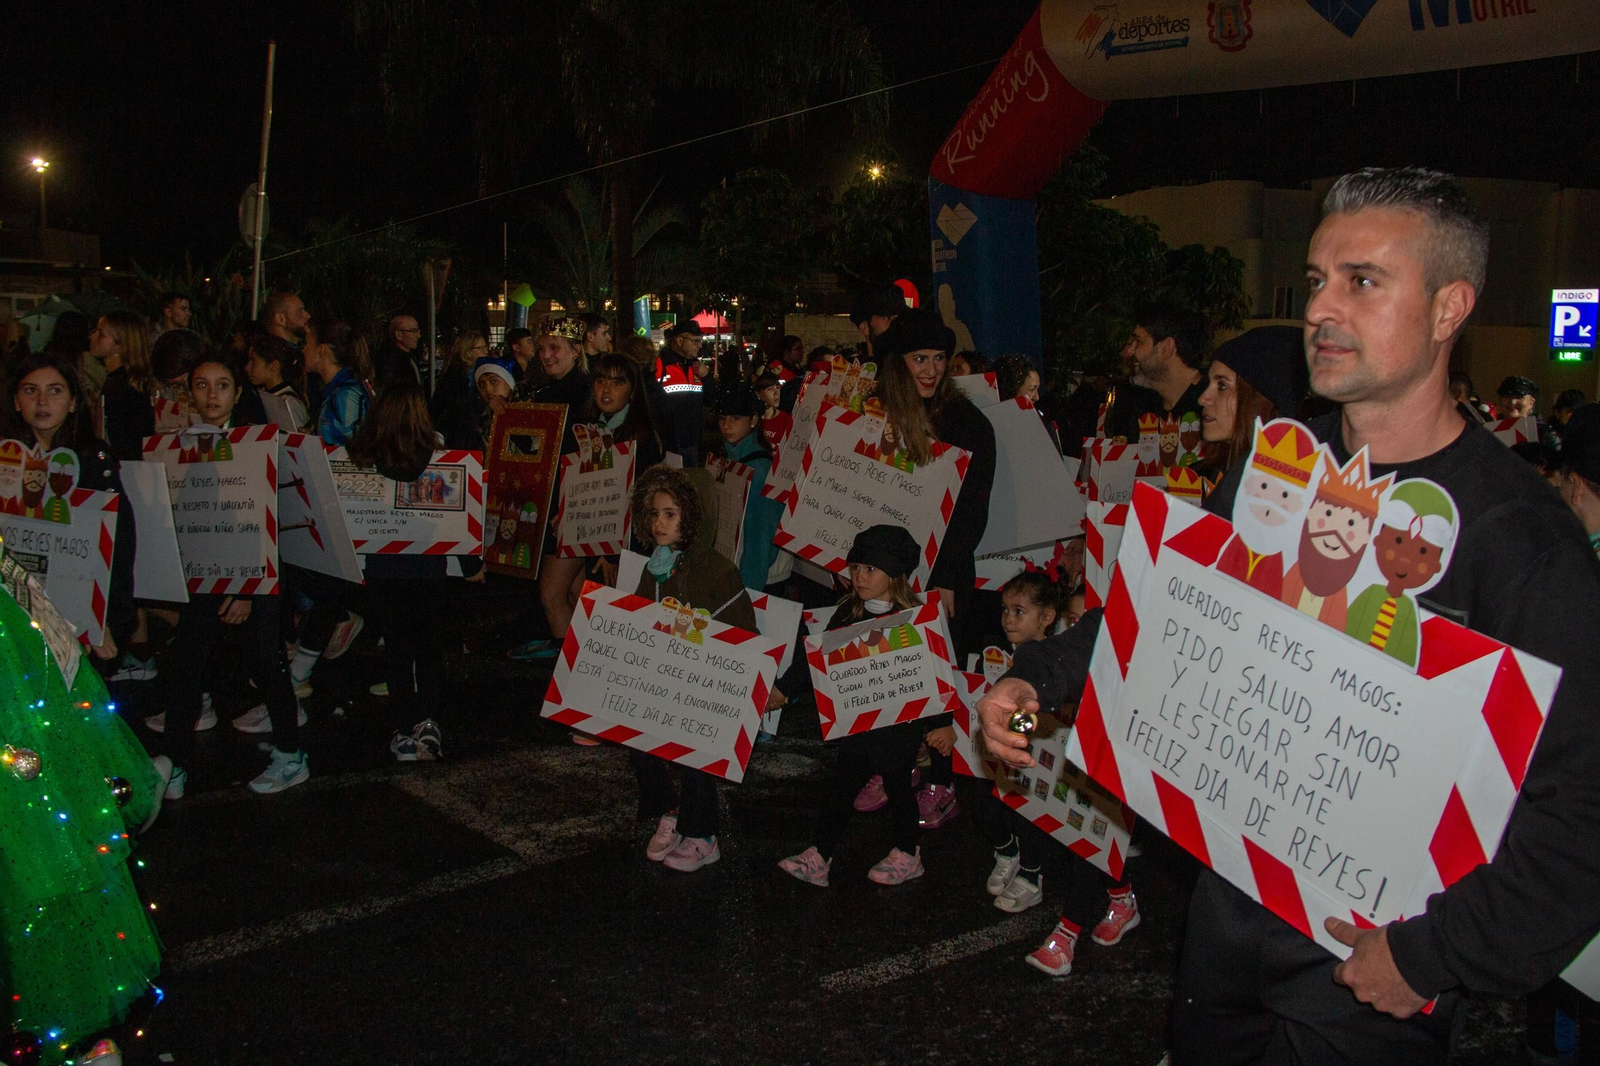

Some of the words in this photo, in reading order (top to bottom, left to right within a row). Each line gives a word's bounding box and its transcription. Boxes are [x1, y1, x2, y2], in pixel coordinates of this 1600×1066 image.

[1119, 18, 1190, 41] deportes
[942, 50, 1050, 174] Running
[1557, 292, 1593, 300] INDIGO
[1554, 305, 1581, 337] P
[1559, 351, 1582, 361] LIBRE
[190, 476, 215, 489] REYES
[820, 446, 861, 474] QUERIDOS
[865, 461, 886, 484] REYES
[890, 472, 925, 497] MAGOS:
[825, 478, 848, 496] MAGIA
[852, 489, 876, 509] SIEMPRE
[1103, 483, 1131, 502] QUERI
[390, 510, 415, 518] REYES
[801, 494, 820, 511] PARA
[847, 515, 865, 530] CREE
[21, 528, 52, 553] REYES
[368, 528, 400, 536] ORIENTE
[225, 565, 236, 577] DE
[589, 614, 656, 648] QUERIDOS
[667, 638, 699, 661] REYES
[705, 652, 750, 675] MAGOS:
[1167, 575, 1243, 632] QUERIDOS
[1257, 623, 1315, 673] REYES
[1330, 666, 1402, 716] MAGOS:
[583, 637, 618, 660] AQUEL
[623, 650, 651, 669] QUE
[657, 663, 683, 680] CREE
[687, 672, 701, 684] EN
[701, 676, 713, 689] LA
[717, 678, 749, 699] MAGIA
[830, 666, 867, 682] QUERIDOS
[869, 659, 890, 672] REYES
[894, 652, 924, 667] MAGOS:
[868, 676, 884, 687] MIS
[607, 670, 669, 698] DESTINADO
[673, 692, 682, 705] A
[684, 696, 740, 719] ENCONTRARLA
[888, 689, 898, 700] DE
[1162, 617, 1224, 674] PIDO
[1239, 665, 1314, 732] SALUD,
[1324, 715, 1401, 778] AMOR
[660, 711, 676, 727] DE
[680, 716, 720, 744] REYES!
[1171, 658, 1189, 689] Y
[1198, 681, 1292, 763] LLEGAR
[1308, 752, 1363, 801] SIN
[1126, 708, 1188, 778] ¡FELIZ
[1244, 801, 1269, 838] DE
[1288, 828, 1389, 919] REYES!
